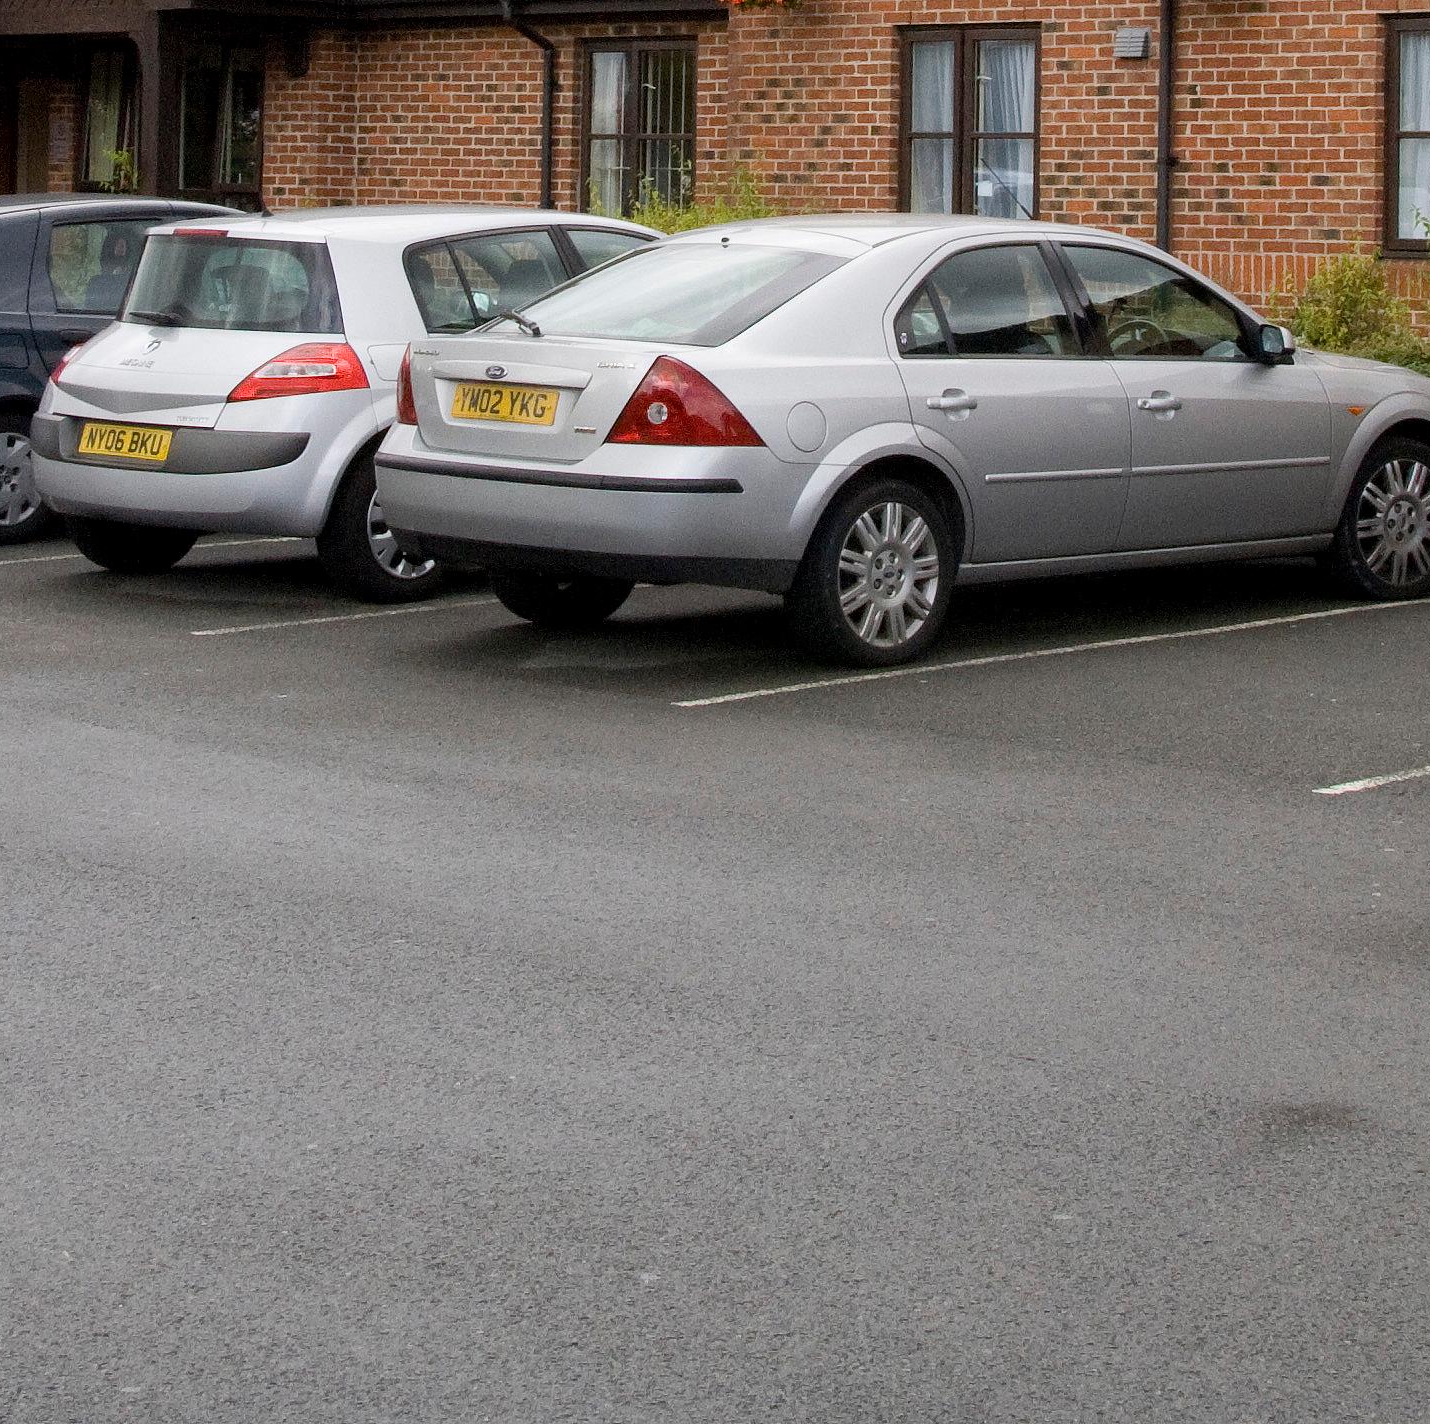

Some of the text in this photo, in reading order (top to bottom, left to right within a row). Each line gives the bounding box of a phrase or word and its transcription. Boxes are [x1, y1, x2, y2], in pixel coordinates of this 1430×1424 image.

[460, 387, 548, 418] YM02 YKG
[86, 428, 163, 456] NY06 BKU
